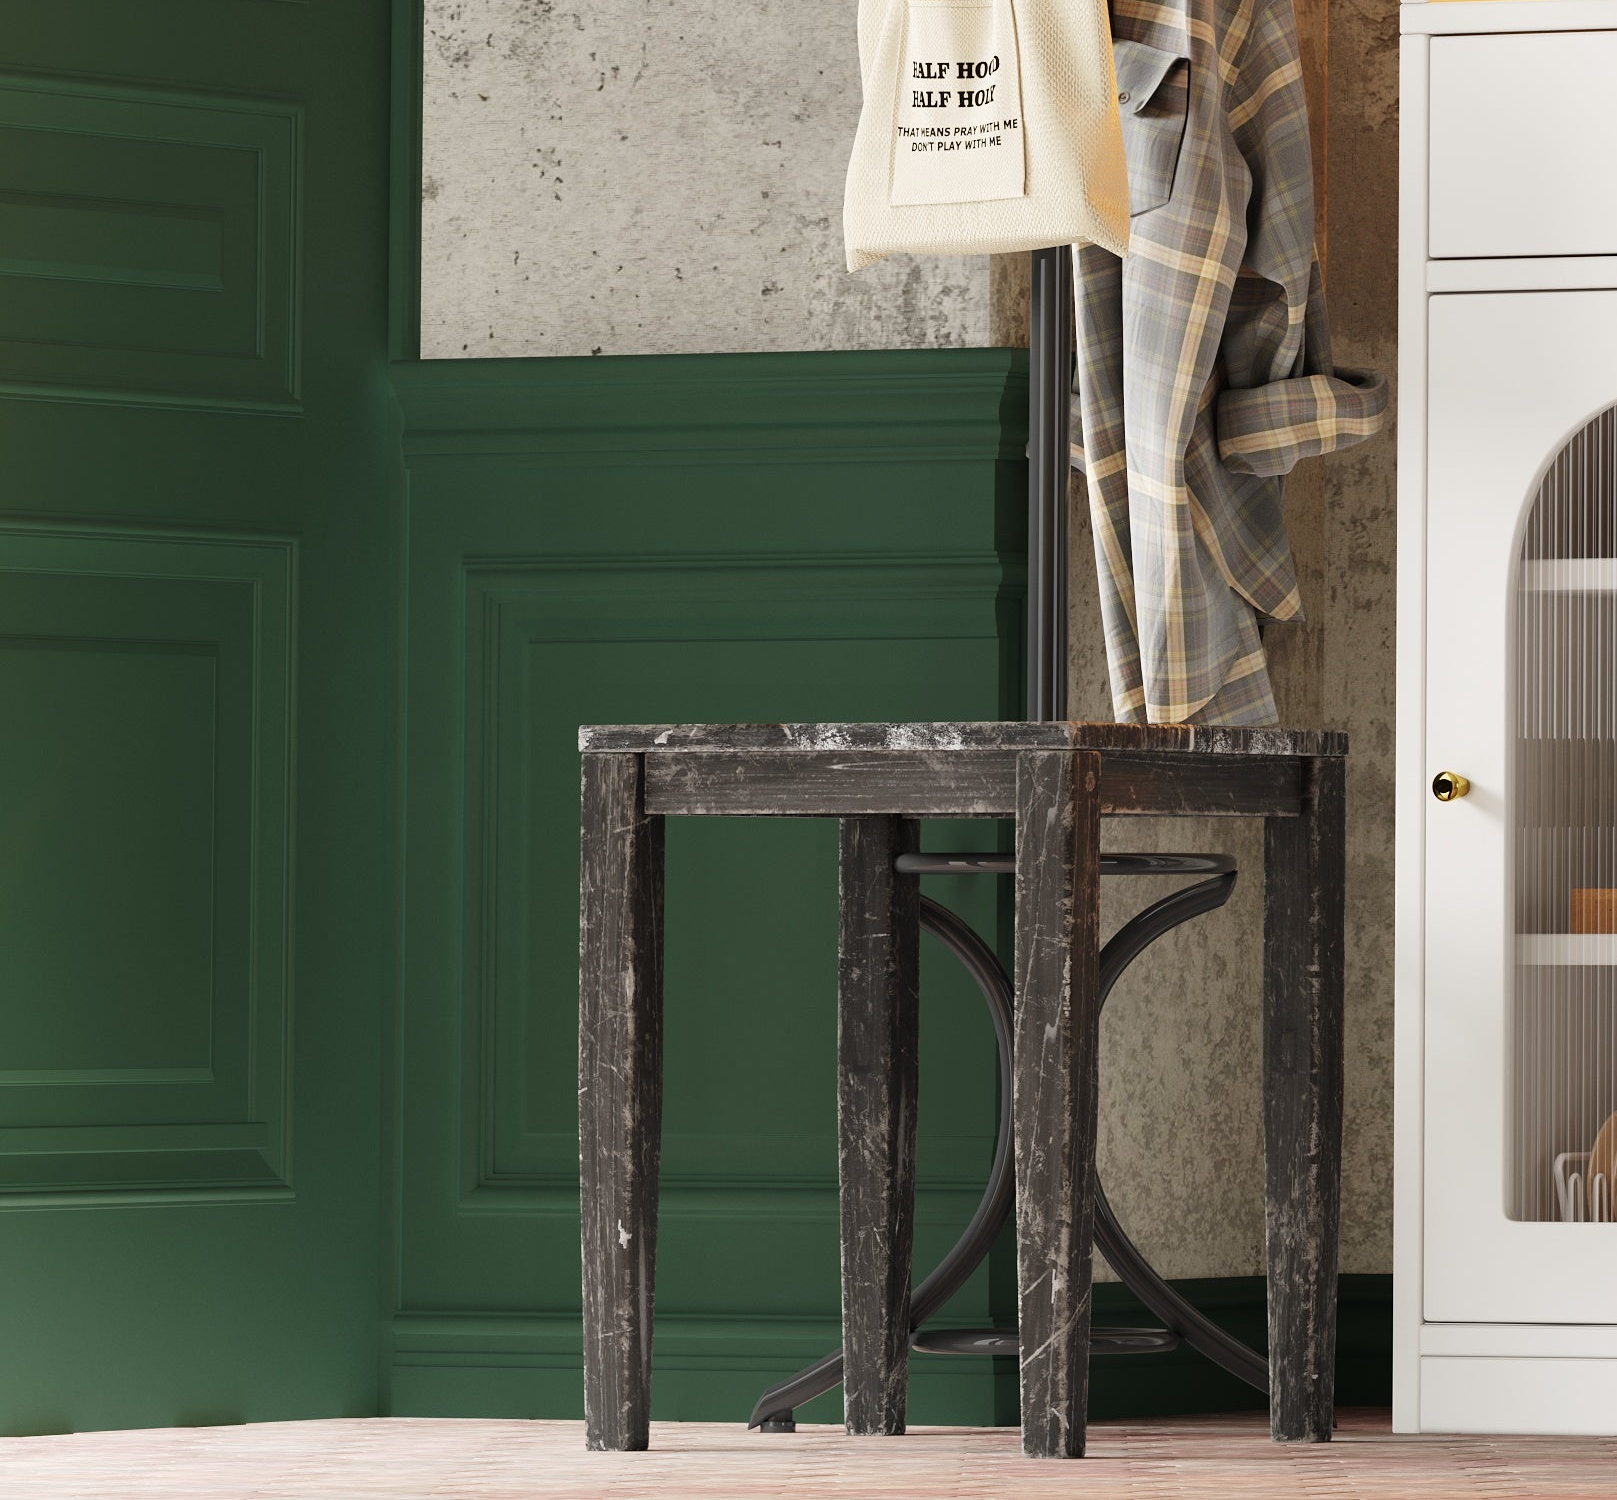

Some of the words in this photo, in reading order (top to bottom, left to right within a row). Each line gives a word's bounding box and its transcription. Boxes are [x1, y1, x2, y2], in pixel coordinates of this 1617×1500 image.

[913, 61, 950, 79] HALF
[912, 90, 951, 108] HALF
[898, 126, 919, 137] THAT
[921, 127, 950, 137] MEANS
[953, 126, 978, 136] PRAY
[980, 121, 999, 133] WITH
[1003, 118, 1018, 130] ME
[937, 141, 962, 151] PLAY
[965, 138, 987, 150] WITH
[989, 135, 1002, 146] ME
